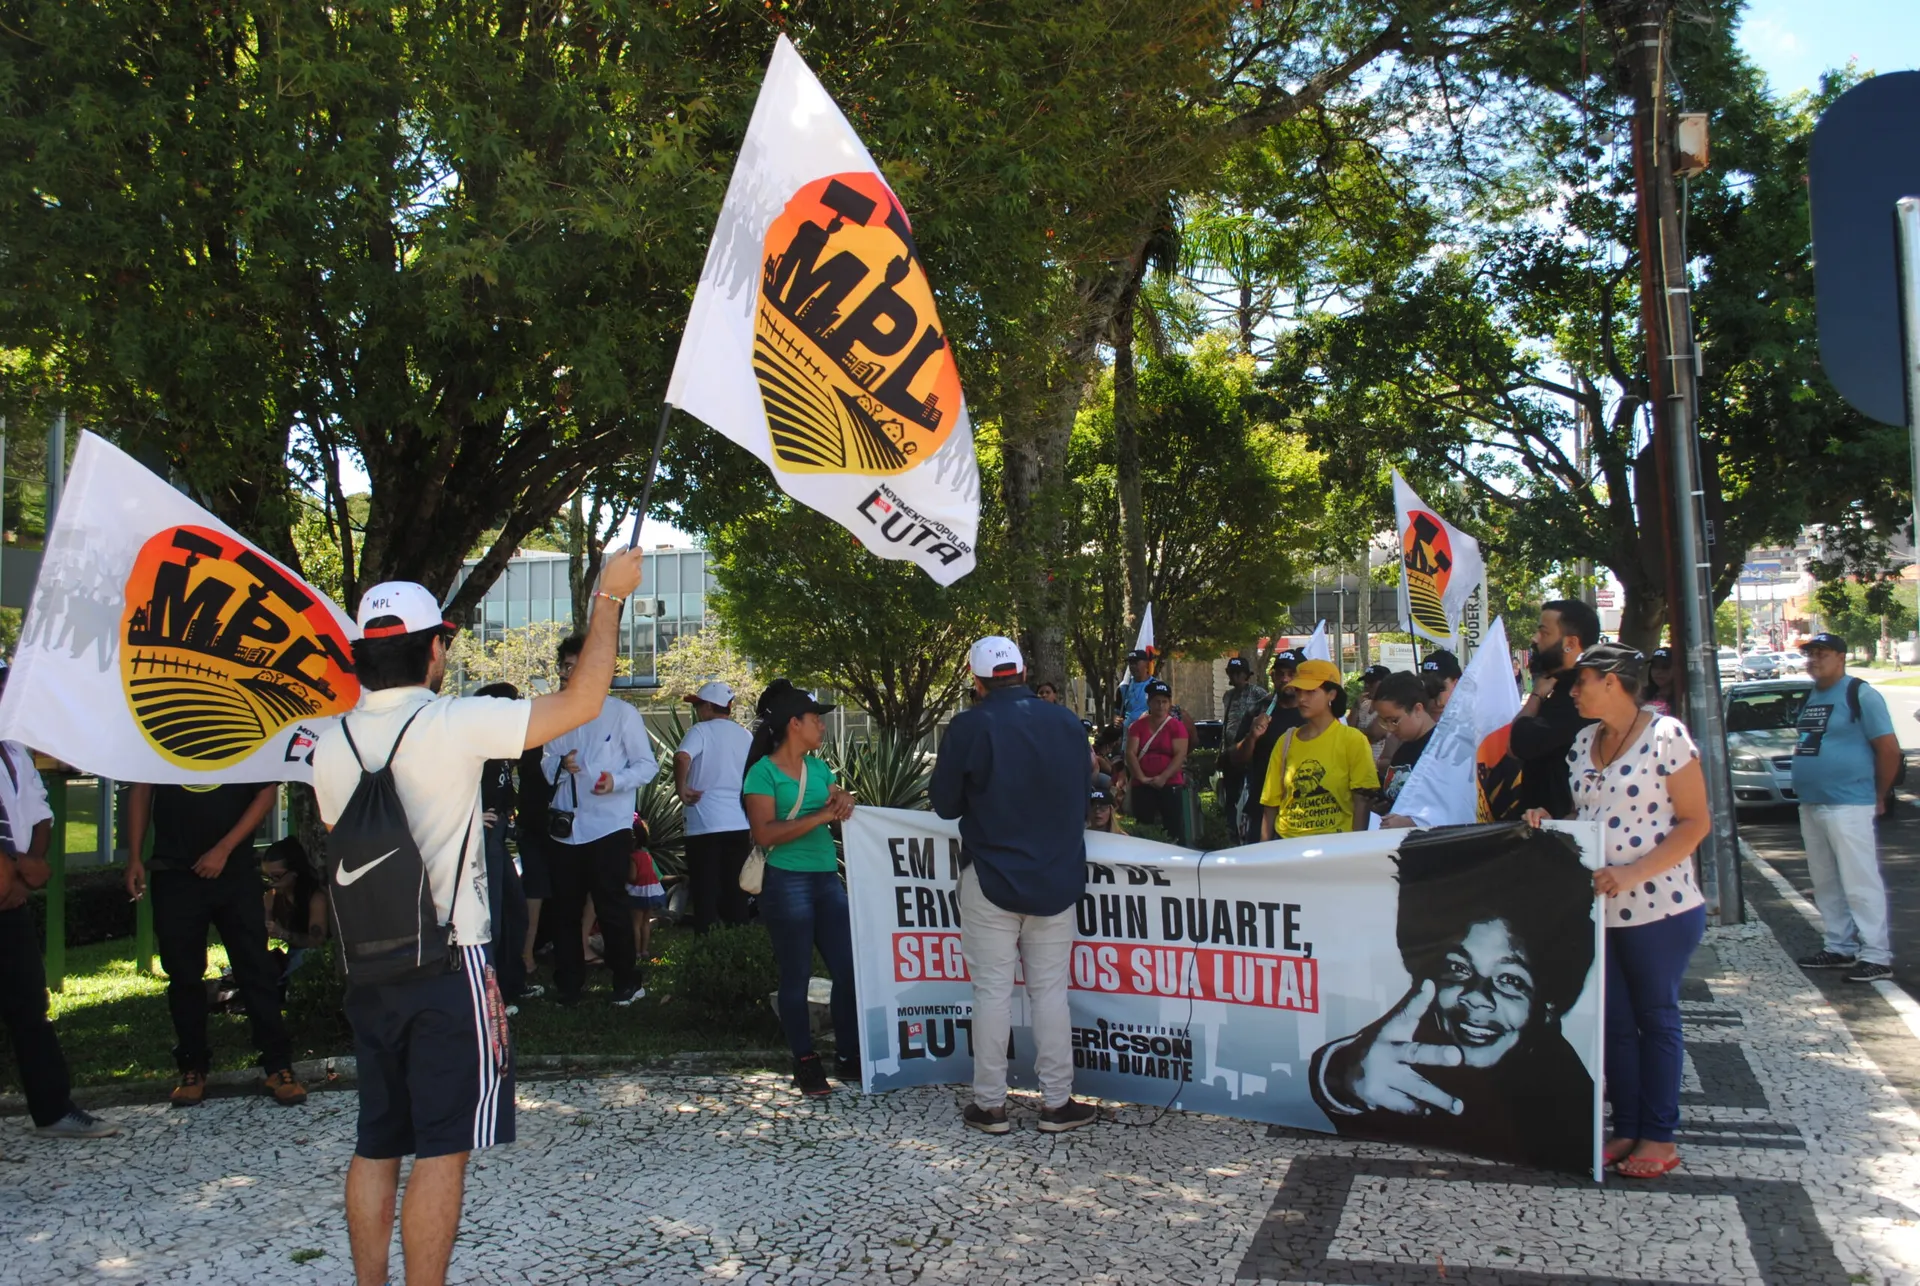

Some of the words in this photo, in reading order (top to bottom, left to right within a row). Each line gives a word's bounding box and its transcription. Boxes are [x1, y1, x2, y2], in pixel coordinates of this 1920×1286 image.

[762, 220, 944, 433] MPL
[856, 489, 963, 566] LUTA
[372, 598, 391, 609] MPL
[128, 560, 338, 702] MPL
[1467, 602, 1480, 648] PODER
[995, 650, 1009, 659] MPL
[1423, 661, 1439, 670] MPL
[888, 838, 935, 880] EM
[1115, 863, 1171, 886] DE
[1076, 893, 1148, 939] OHN
[1161, 896, 1313, 959] DUARTE,
[1131, 948, 1203, 997] SUA
[1214, 953, 1313, 1010] LUTA!
[897, 1005, 962, 1017] MOVIMENTO
[909, 1025, 920, 1033] DE
[1111, 1022, 1190, 1038] COMUNIDADE
[1073, 1048, 1111, 1072] OHN
[1119, 1053, 1193, 1083] DUARTE
